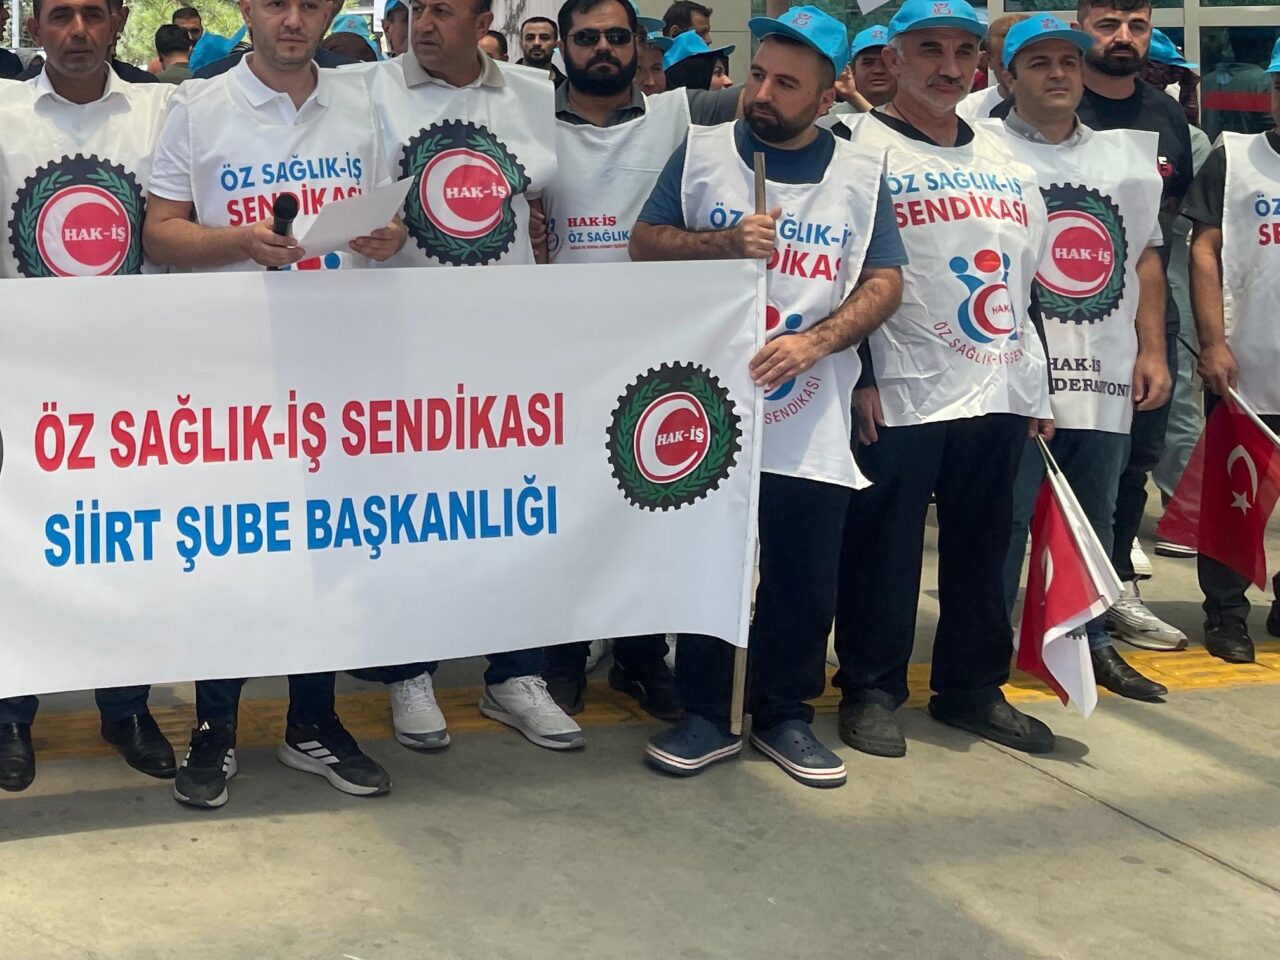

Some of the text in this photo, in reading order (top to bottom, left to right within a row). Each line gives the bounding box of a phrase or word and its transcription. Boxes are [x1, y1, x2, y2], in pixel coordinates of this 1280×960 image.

[220, 151, 363, 192] ÖZ SAĞLIK-İŞ
[886, 167, 1024, 201] ÖZ SAĞLIK-İŞ
[445, 182, 508, 199] HAK-İŞ
[893, 191, 1029, 229] SENDİKASI
[64, 224, 126, 242] HAK-İŞ
[586, 229, 631, 243] SAĞLIK
[1054, 247, 1111, 265] HAK-İŞ
[764, 375, 822, 425] SENDİKASI
[34, 383, 565, 473] ÖZ SAĞLIK-İŞ SENDİKASI
[656, 425, 705, 446] HAK-İŞ
[43, 475, 558, 573] SİİRT ŞUBE BAŞKANLIĞI
